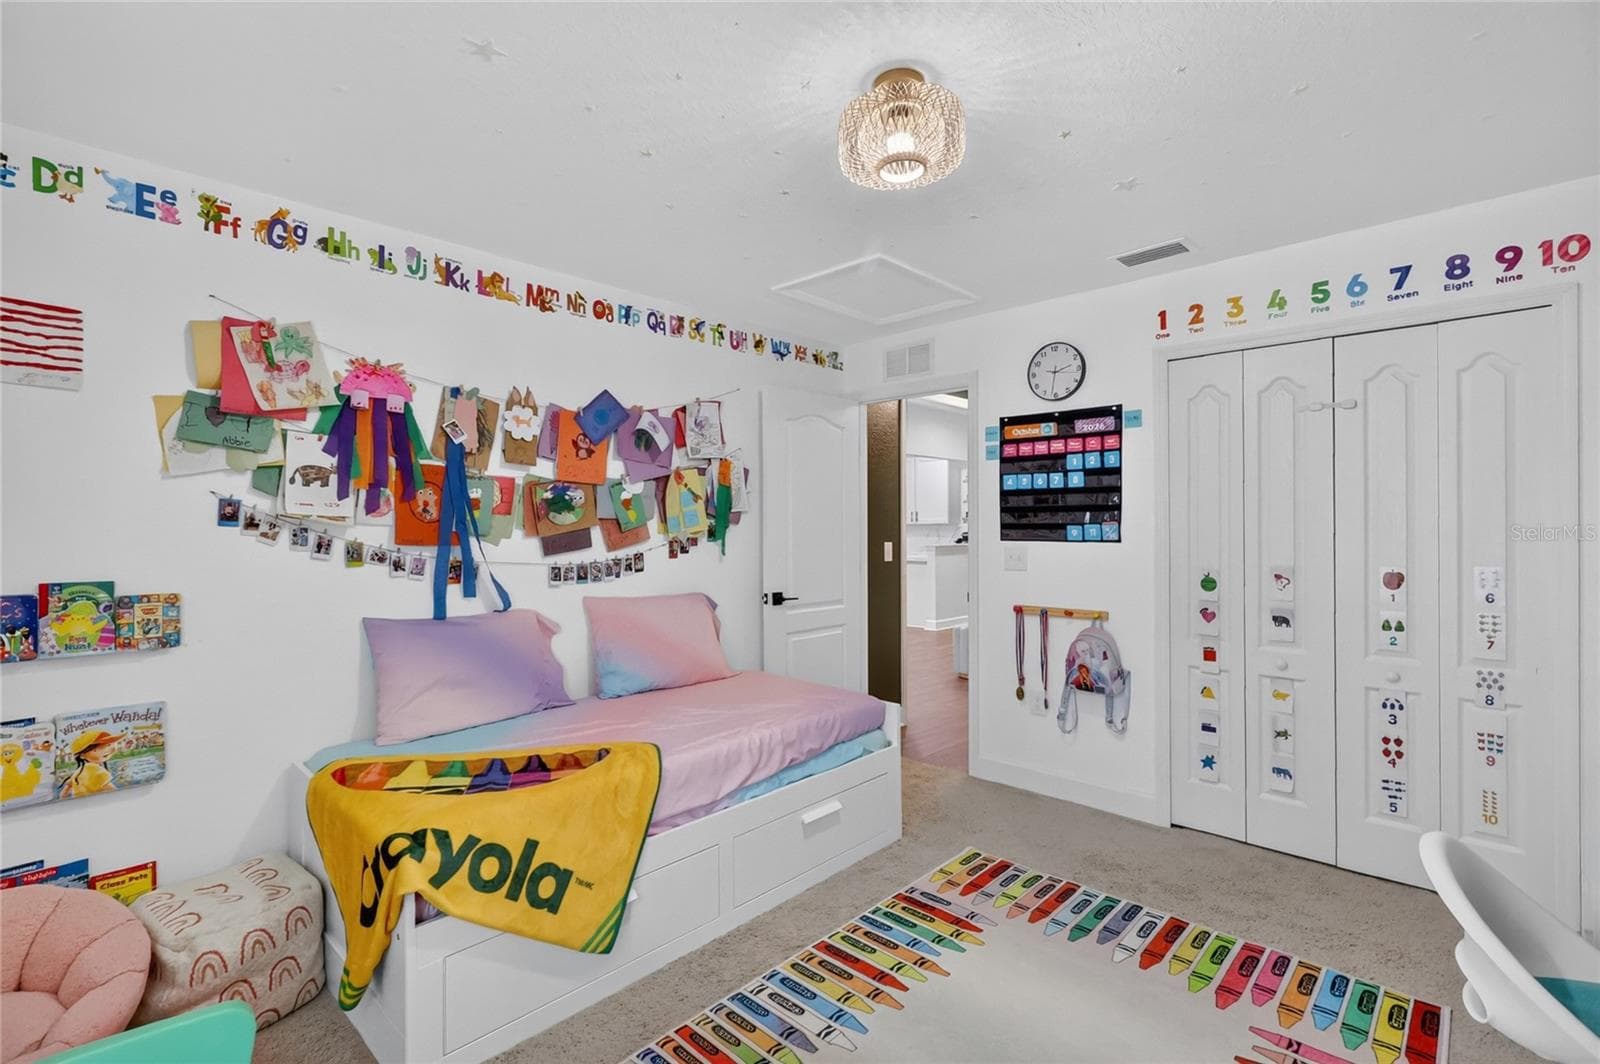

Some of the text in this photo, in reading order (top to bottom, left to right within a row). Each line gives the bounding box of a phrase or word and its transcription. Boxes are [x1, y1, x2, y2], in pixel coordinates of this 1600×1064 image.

[32, 156, 83, 193] Dd
[135, 182, 178, 220] Ee
[214, 204, 241, 238] Ff
[266, 218, 308, 250] Gg
[328, 227, 360, 261] Hh
[407, 249, 427, 280] Jj
[444, 261, 470, 293] Kk
[646, 310, 667, 337] Qq
[1157, 233, 1592, 331] 1 2 3 4 5 6 7 8 9 10
[1311, 306, 1330, 314] Five
[1386, 290, 1419, 302] Seven
[1444, 280, 1474, 292] Eight
[1496, 273, 1524, 285] Nine
[1551, 265, 1576, 274] Ten
[1485, 592, 1495, 604] 6
[1389, 636, 1398, 646] 2
[1486, 640, 1495, 650] 7
[1485, 694, 1495, 706] 8
[59, 717, 109, 736] Whatever
[110, 707, 162, 724] Wanda!
[1388, 714, 1398, 725] 3
[1387, 757, 1397, 768] 4
[1485, 755, 1496, 767] 9
[1389, 802, 1398, 813] 5
[1482, 813, 1498, 825] 10
[99, 879, 126, 890] Class
[128, 873, 148, 883] Pets
